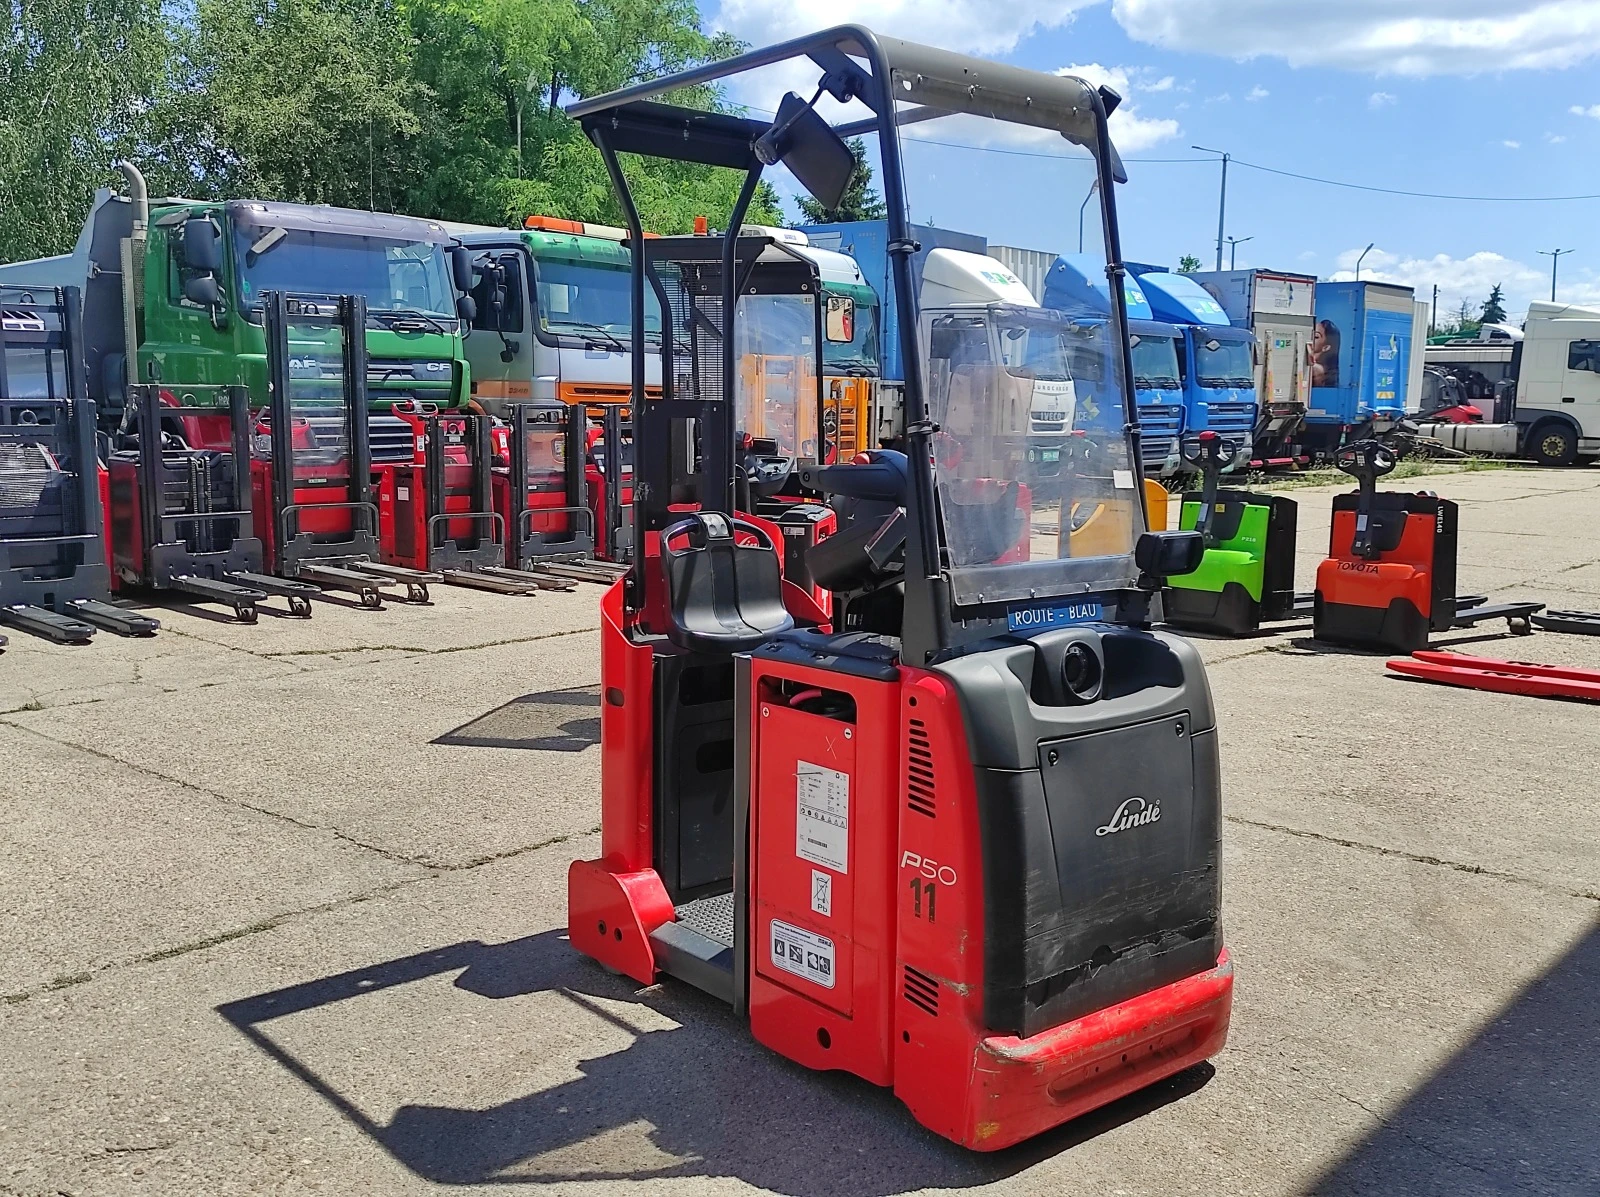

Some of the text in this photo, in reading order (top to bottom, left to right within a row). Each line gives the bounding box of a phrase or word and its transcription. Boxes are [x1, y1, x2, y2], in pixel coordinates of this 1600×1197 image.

[288, 359, 316, 369] AF
[426, 362, 450, 372] CF
[1040, 412, 1062, 420] IVECO
[1437, 506, 1445, 533] LWE140
[1337, 562, 1379, 574] TOYOTA
[1015, 608, 1055, 626] ROUTE
[1069, 603, 1097, 619] BLAU
[1096, 797, 1161, 836] Linde
[901, 850, 957, 886] P50
[817, 903, 828, 913] Pb
[910, 877, 936, 923] 11
